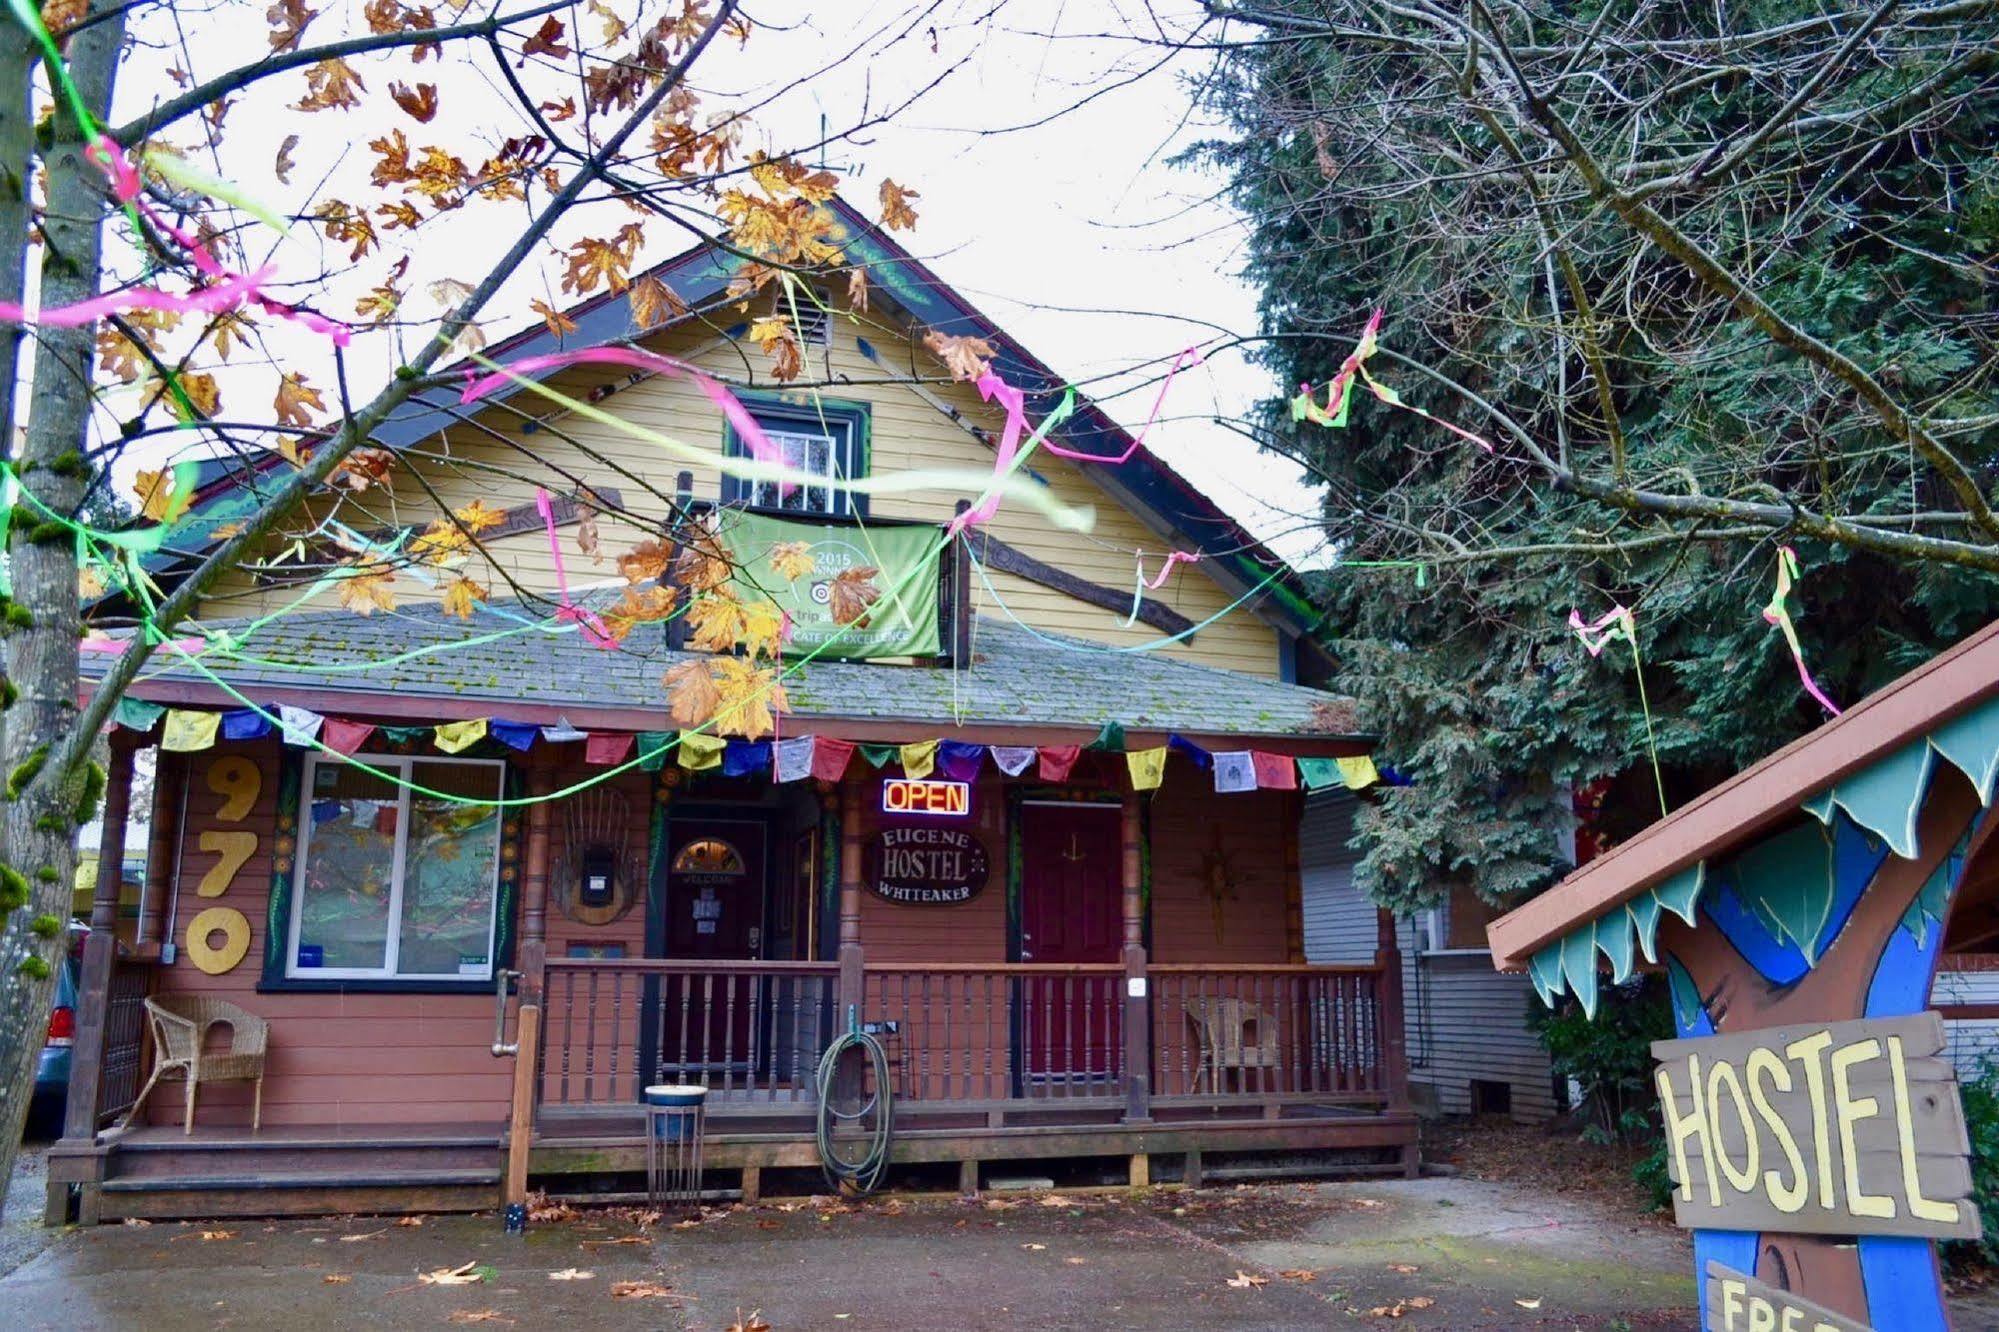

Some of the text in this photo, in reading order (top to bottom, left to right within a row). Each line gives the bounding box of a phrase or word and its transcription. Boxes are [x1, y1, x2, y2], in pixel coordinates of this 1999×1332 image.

[817, 551, 852, 566] 2015
[886, 782, 966, 813] OPEN
[881, 828, 970, 848] EUGENE
[883, 848, 968, 881] HOSTEL
[879, 880, 970, 901] WHITEAKER
[1657, 1029, 1960, 1224] HOSTEL
